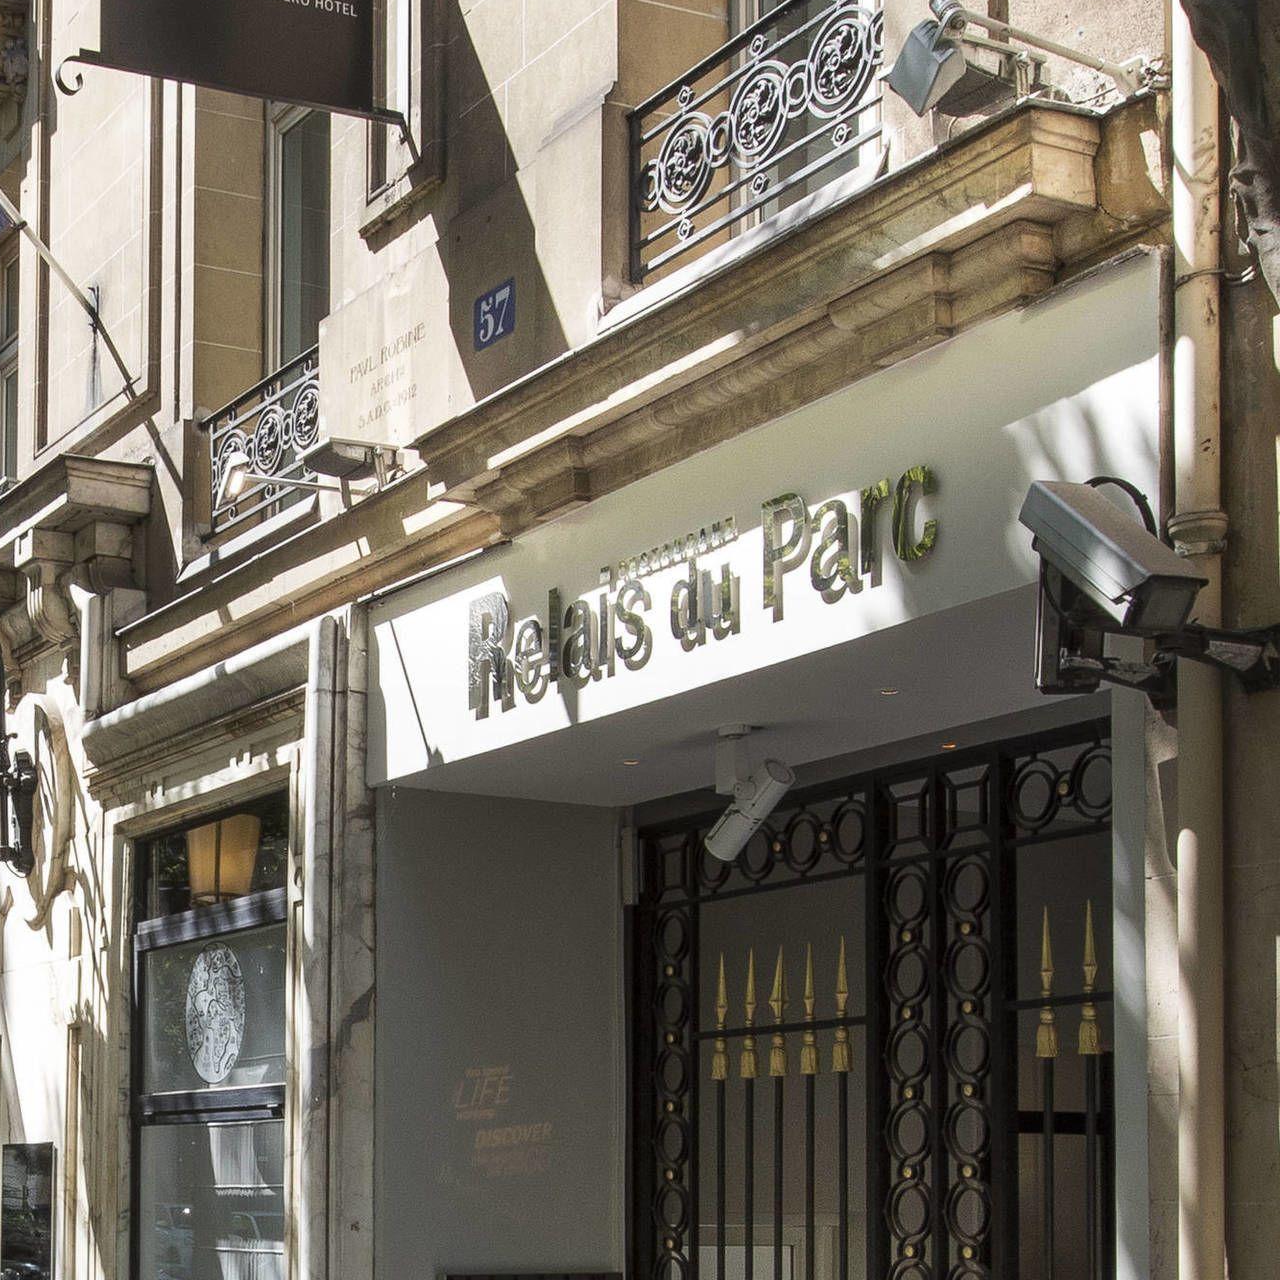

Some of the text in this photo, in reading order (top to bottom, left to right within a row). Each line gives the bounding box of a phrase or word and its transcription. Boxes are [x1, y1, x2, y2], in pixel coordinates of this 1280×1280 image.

[479, 285, 511, 342] 57
[468, 465, 940, 714] Relais du Parc
